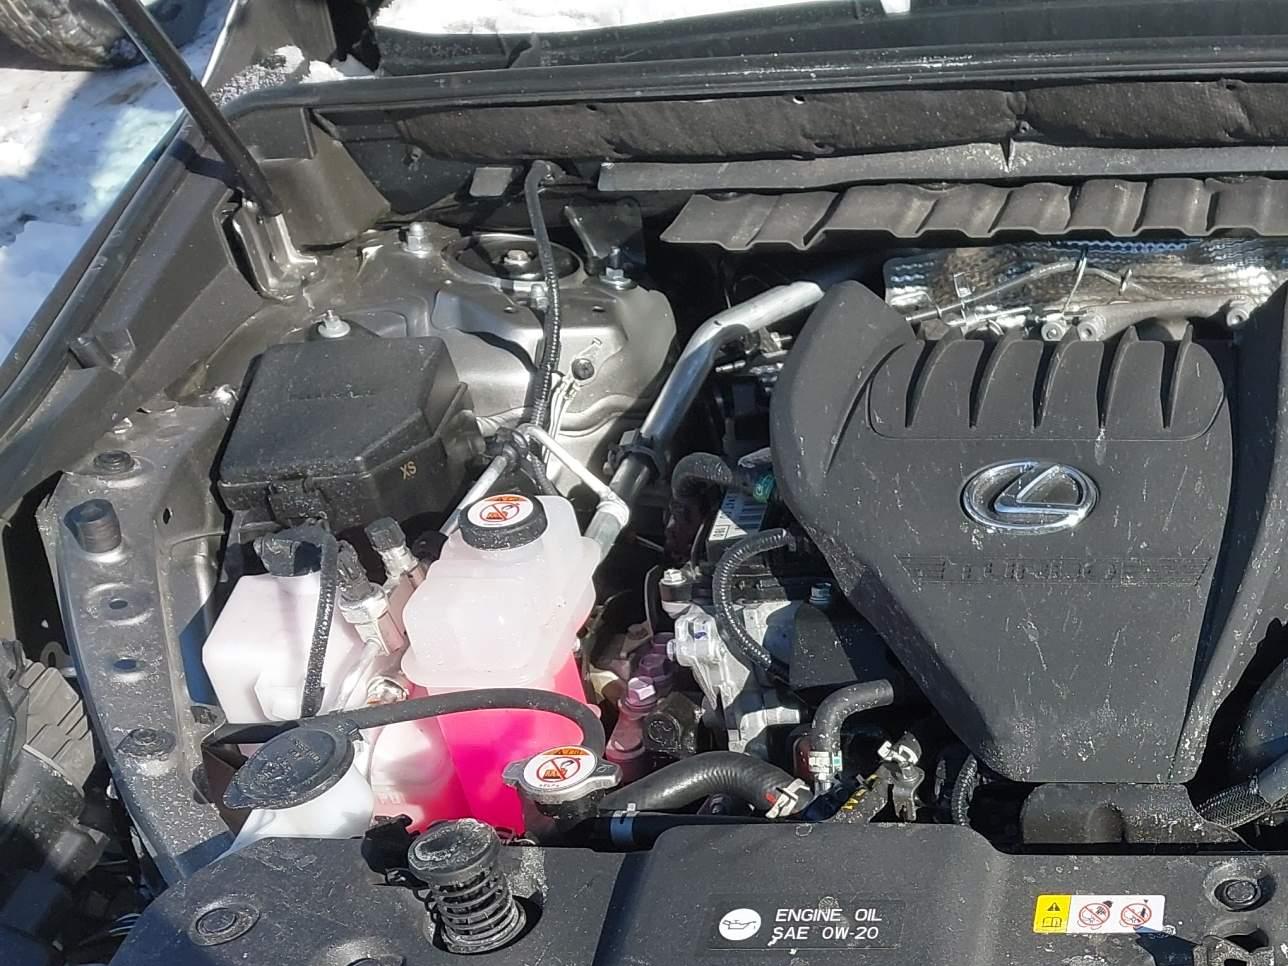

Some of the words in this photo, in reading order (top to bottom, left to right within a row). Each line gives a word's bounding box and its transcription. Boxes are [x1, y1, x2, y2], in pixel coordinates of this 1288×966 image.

[775, 908, 842, 922] ENGINE
[854, 908, 883, 922] OIL
[772, 926, 810, 940] SAE
[822, 926, 879, 940] 0W-20
